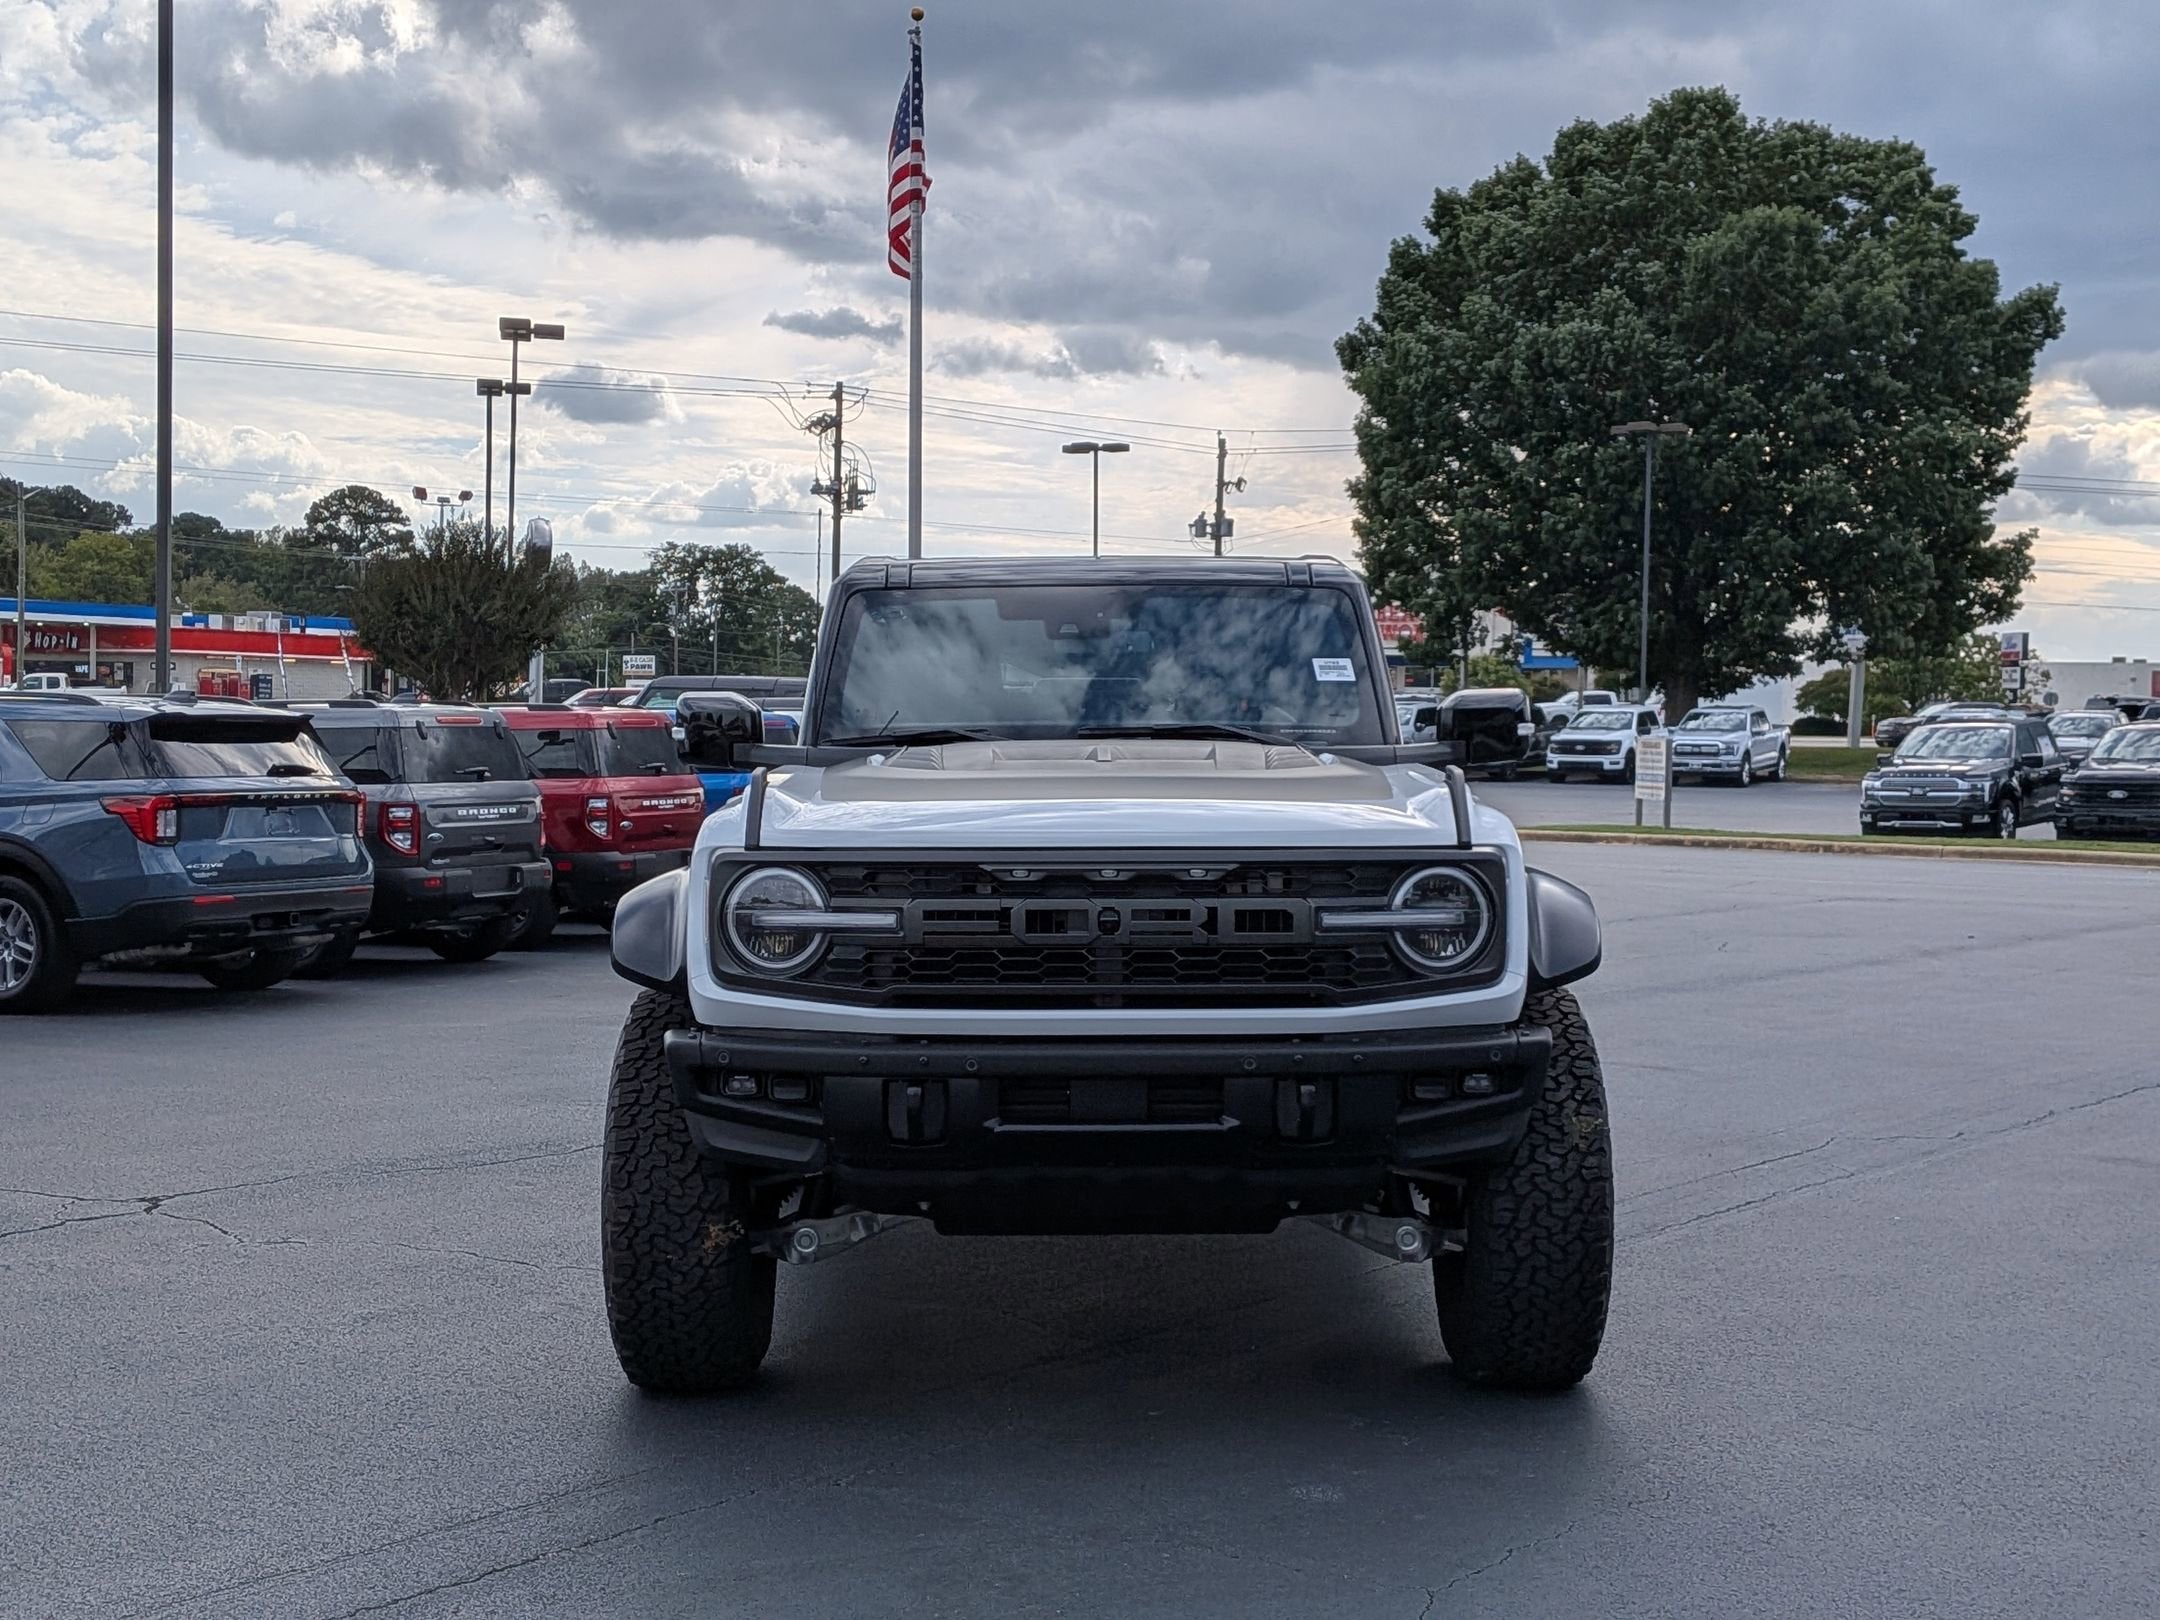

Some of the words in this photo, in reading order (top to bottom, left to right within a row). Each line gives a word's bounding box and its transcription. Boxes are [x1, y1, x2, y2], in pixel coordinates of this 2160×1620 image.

[642, 798, 687, 806] BRONCO
[457, 807, 517, 816] BRONCO
[905, 897, 1312, 945] FORD
